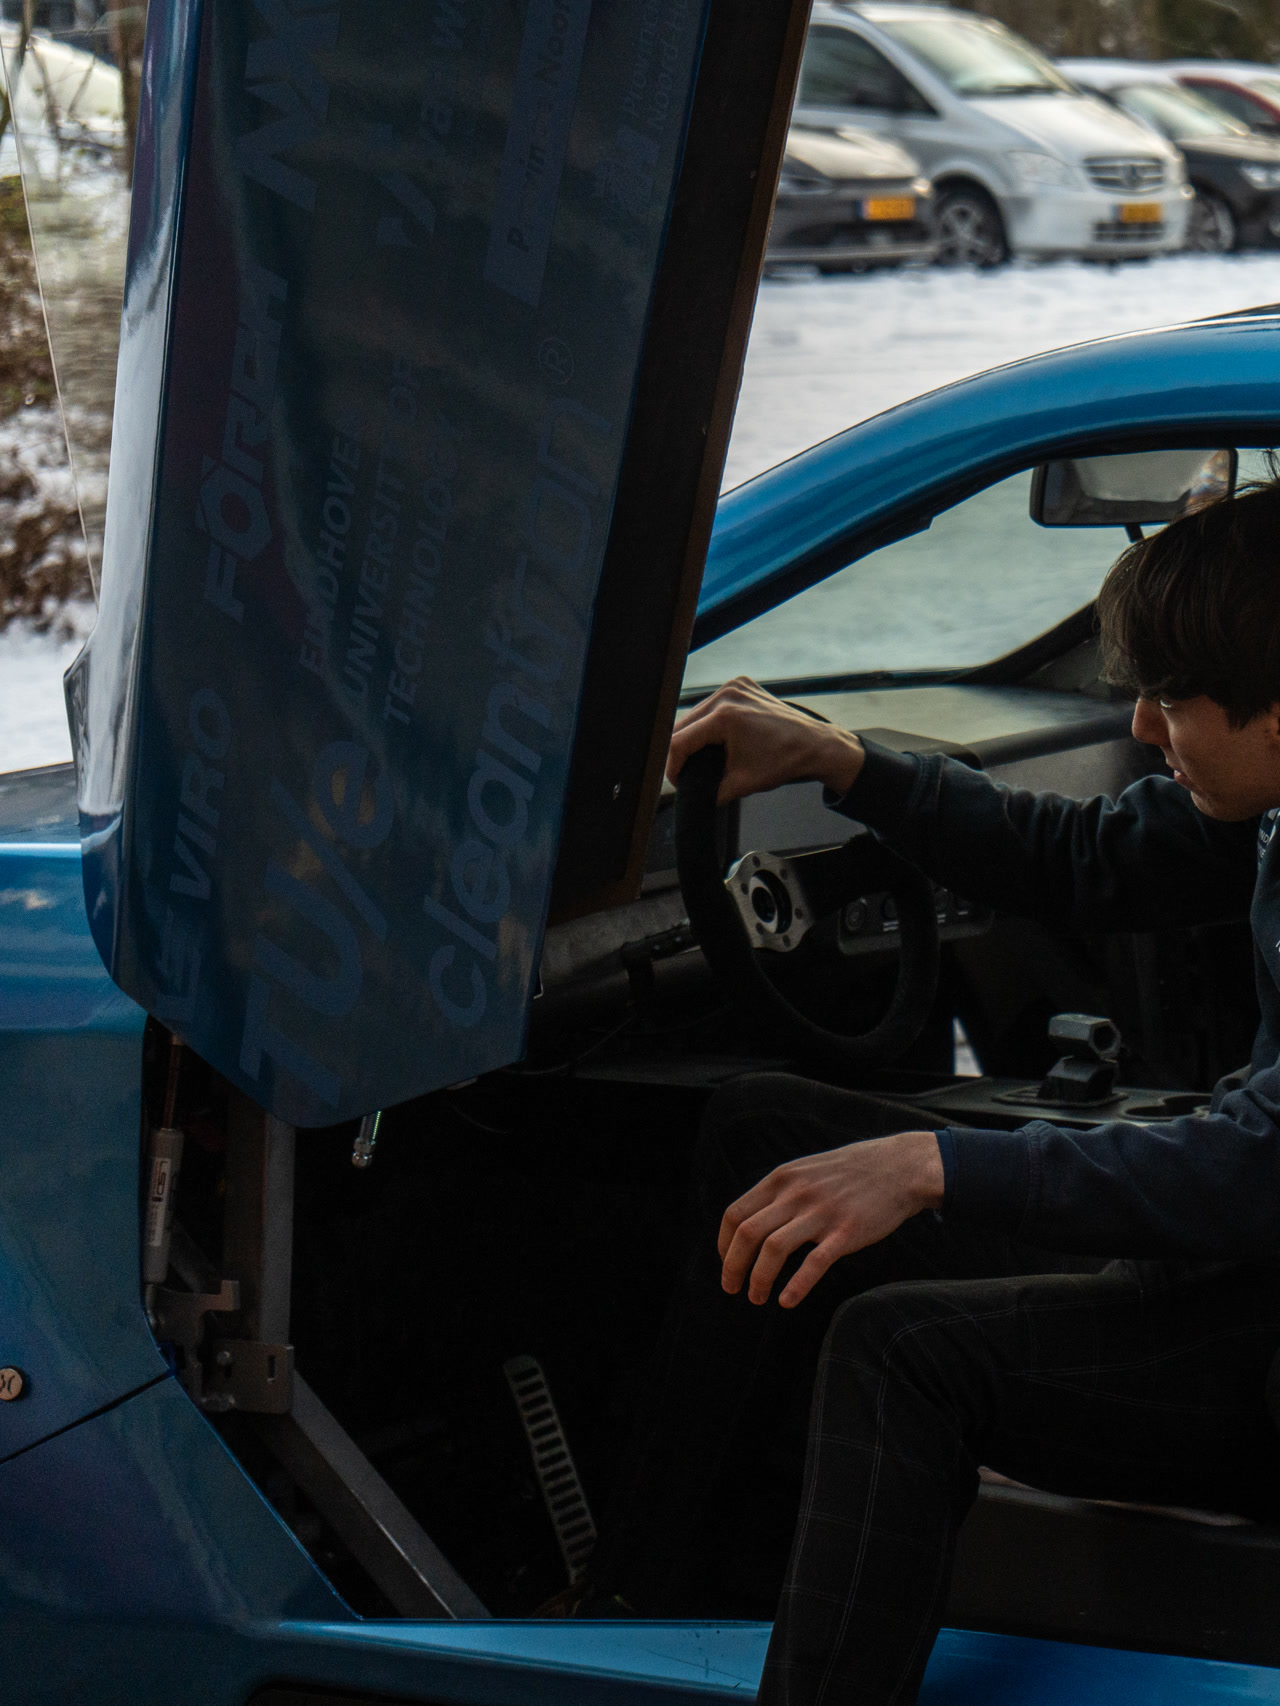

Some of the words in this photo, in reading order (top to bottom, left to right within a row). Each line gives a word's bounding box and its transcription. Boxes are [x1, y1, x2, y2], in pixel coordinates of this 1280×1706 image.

[299, 403, 365, 677] EINDHOVEN
[336, 430, 411, 701] UNIVERSITY
[387, 357, 421, 424] OF
[384, 409, 462, 726] TECHNOLOGY
[169, 687, 232, 901] VIRO
[239, 739, 395, 1109] TU/e
